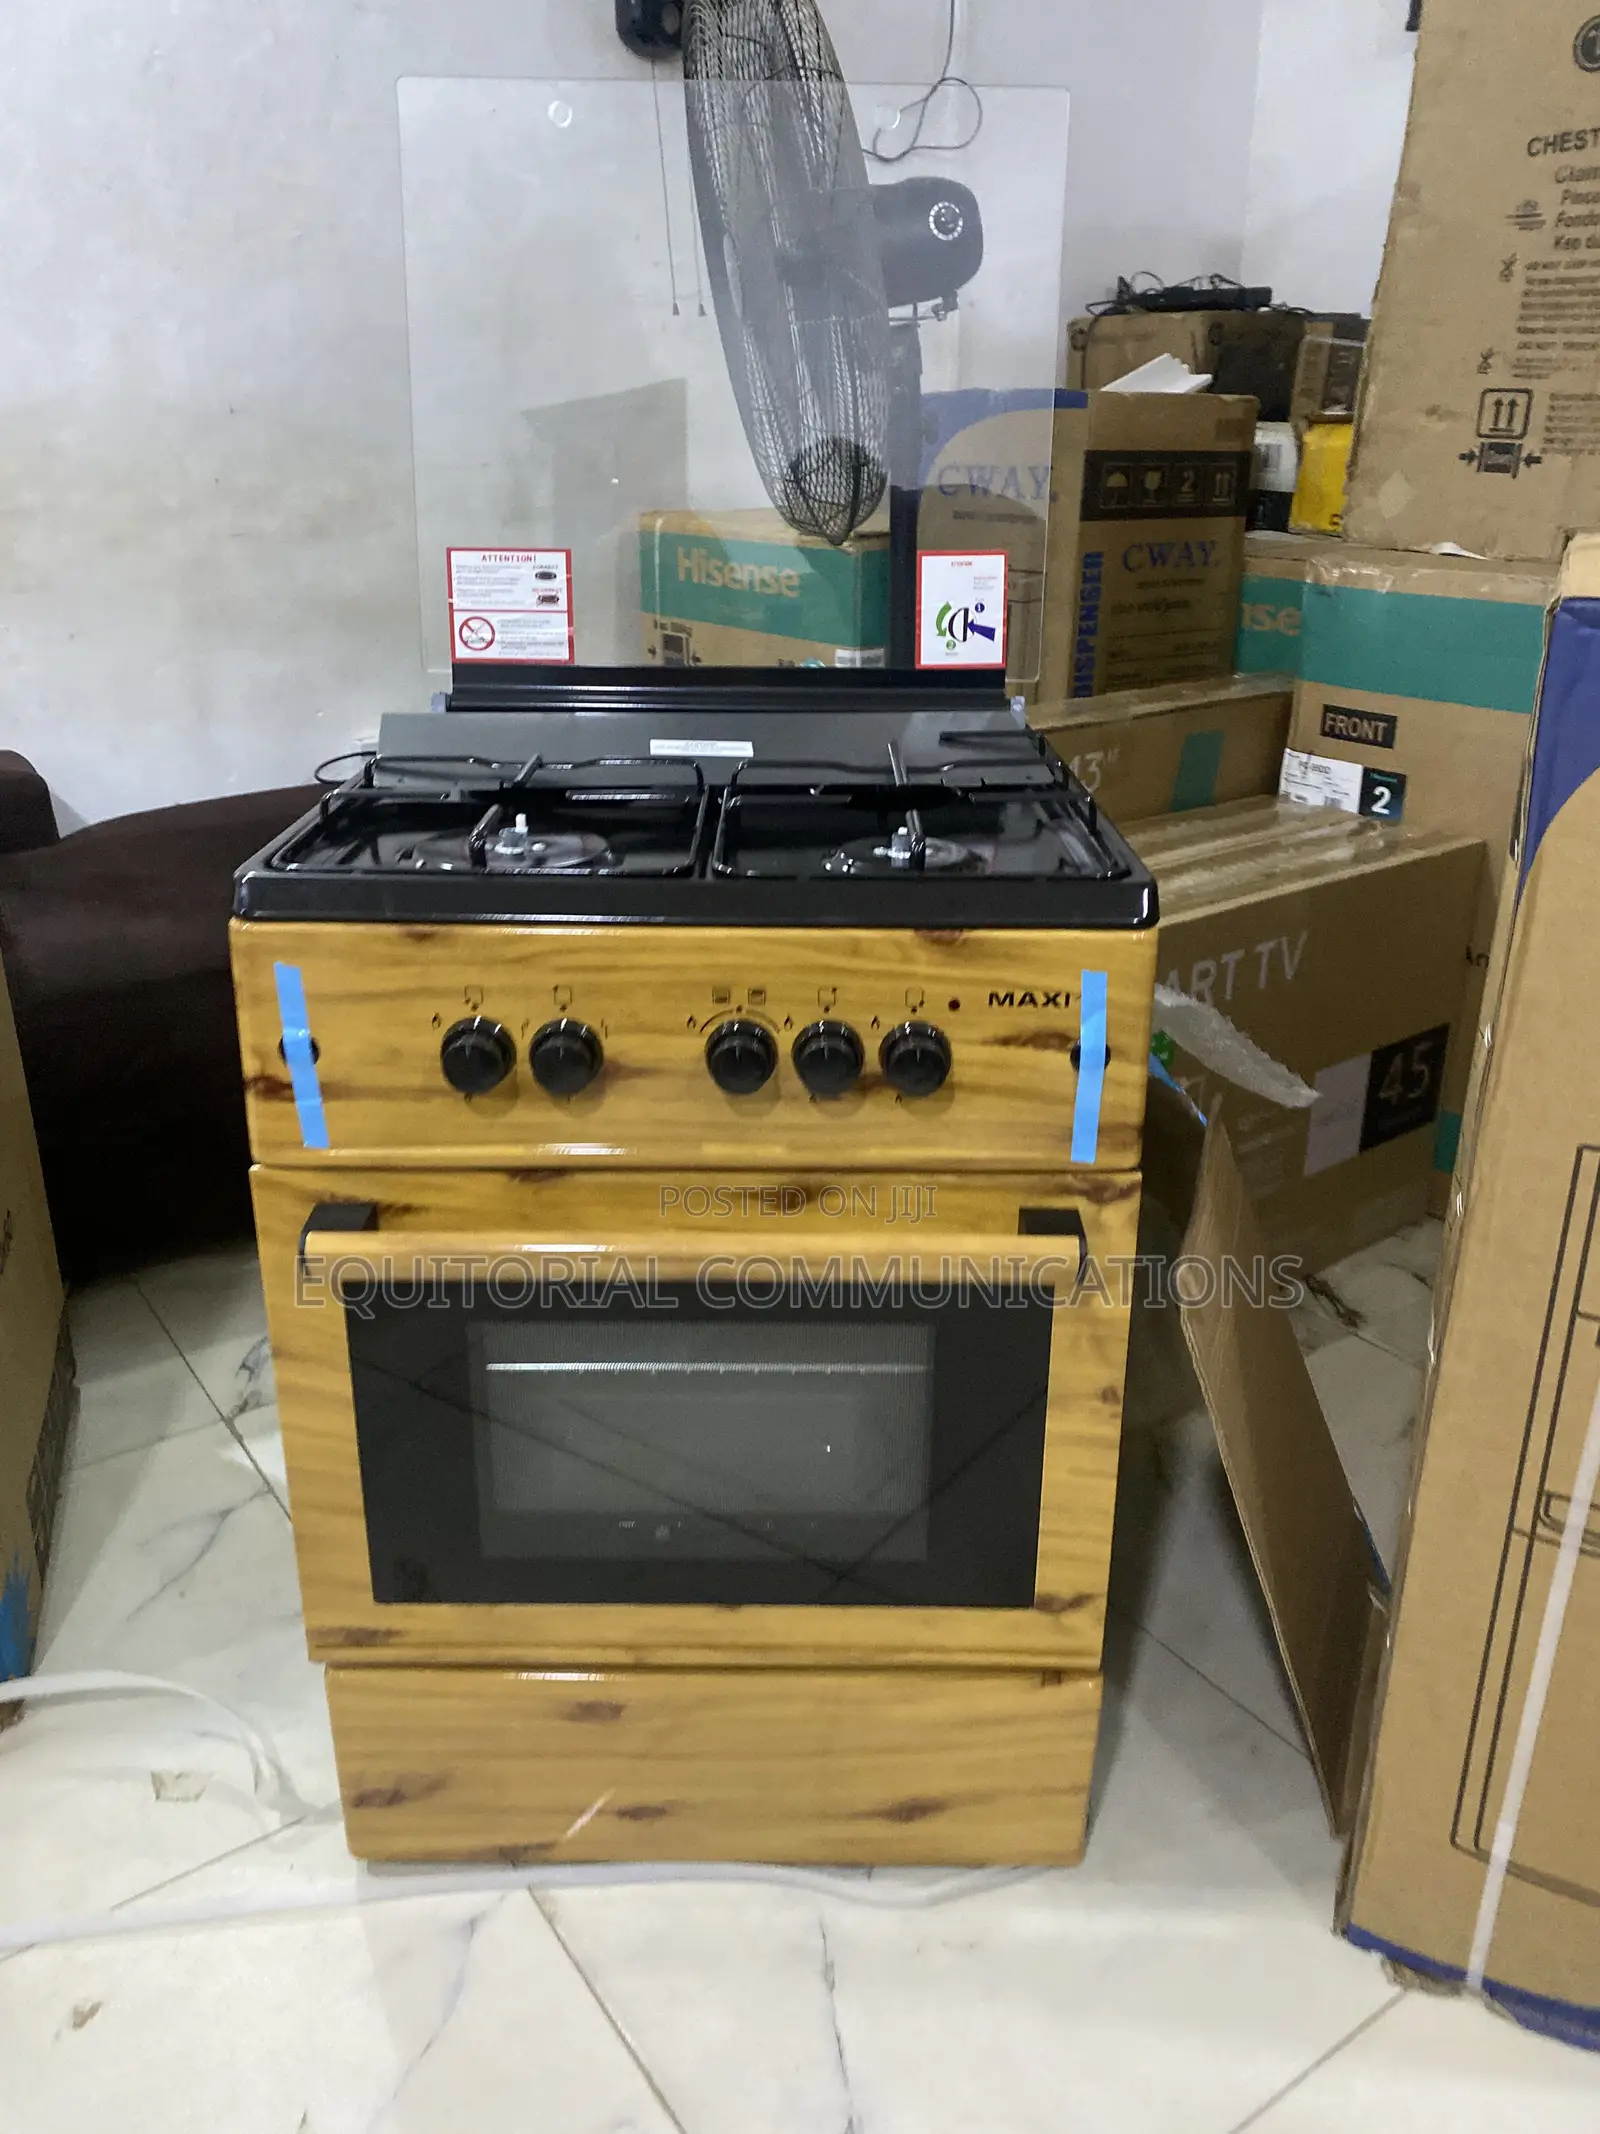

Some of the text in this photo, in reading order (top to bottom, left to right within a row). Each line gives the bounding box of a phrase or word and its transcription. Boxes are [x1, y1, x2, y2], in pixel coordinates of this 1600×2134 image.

[1527, 128, 1600, 157] CHEST
[677, 547, 799, 597] Hisense
[1324, 712, 1388, 742] FRONT
[1371, 786, 1392, 815] 2
[1254, 931, 1308, 989] TV
